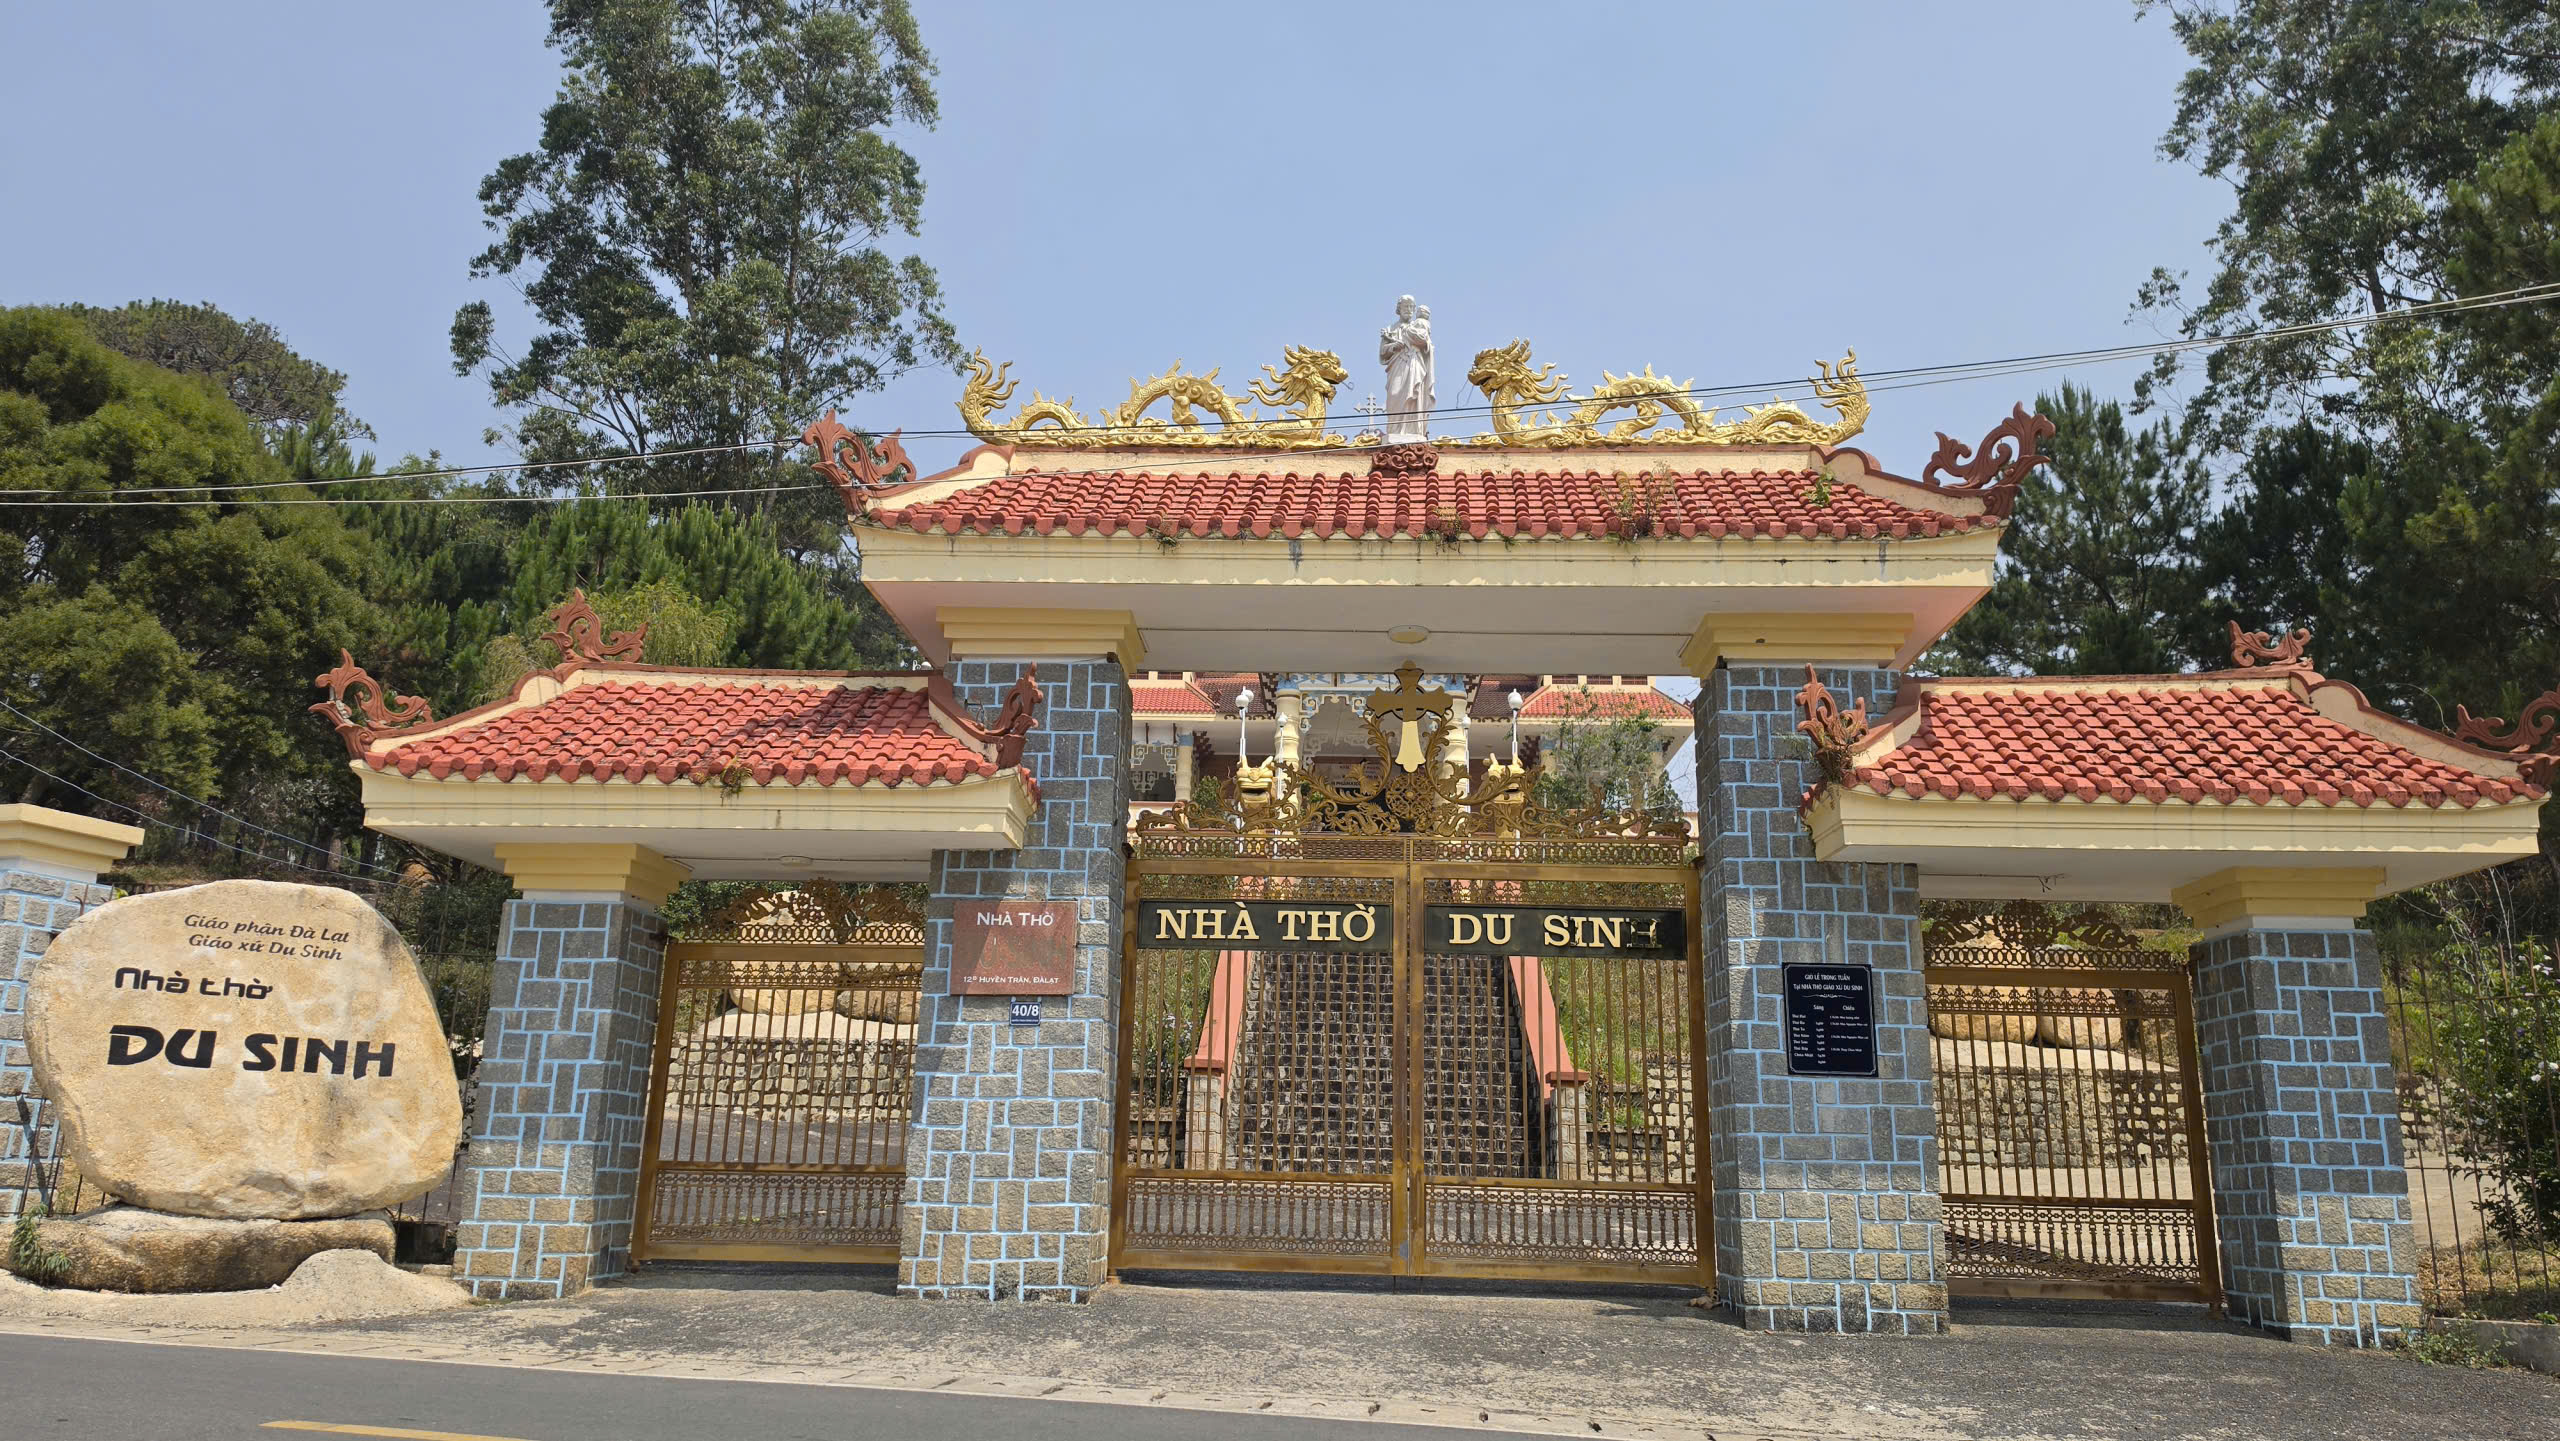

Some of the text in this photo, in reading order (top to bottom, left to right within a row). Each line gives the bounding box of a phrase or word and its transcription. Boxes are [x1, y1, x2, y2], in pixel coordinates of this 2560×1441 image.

[184, 914, 229, 930] Giáo
[289, 925, 316, 940] Đà
[320, 928, 350, 944] Lạt
[976, 911, 1054, 927] NHÀ THỜ
[1155, 901, 1663, 949] NHÀ THỜ DU SINH
[188, 933, 343, 961] Giáo xứ Du Sinh
[115, 967, 274, 1000] Nhà thờ
[1012, 1005, 1039, 1017] 40/8
[107, 1024, 396, 1081] DU SINH
